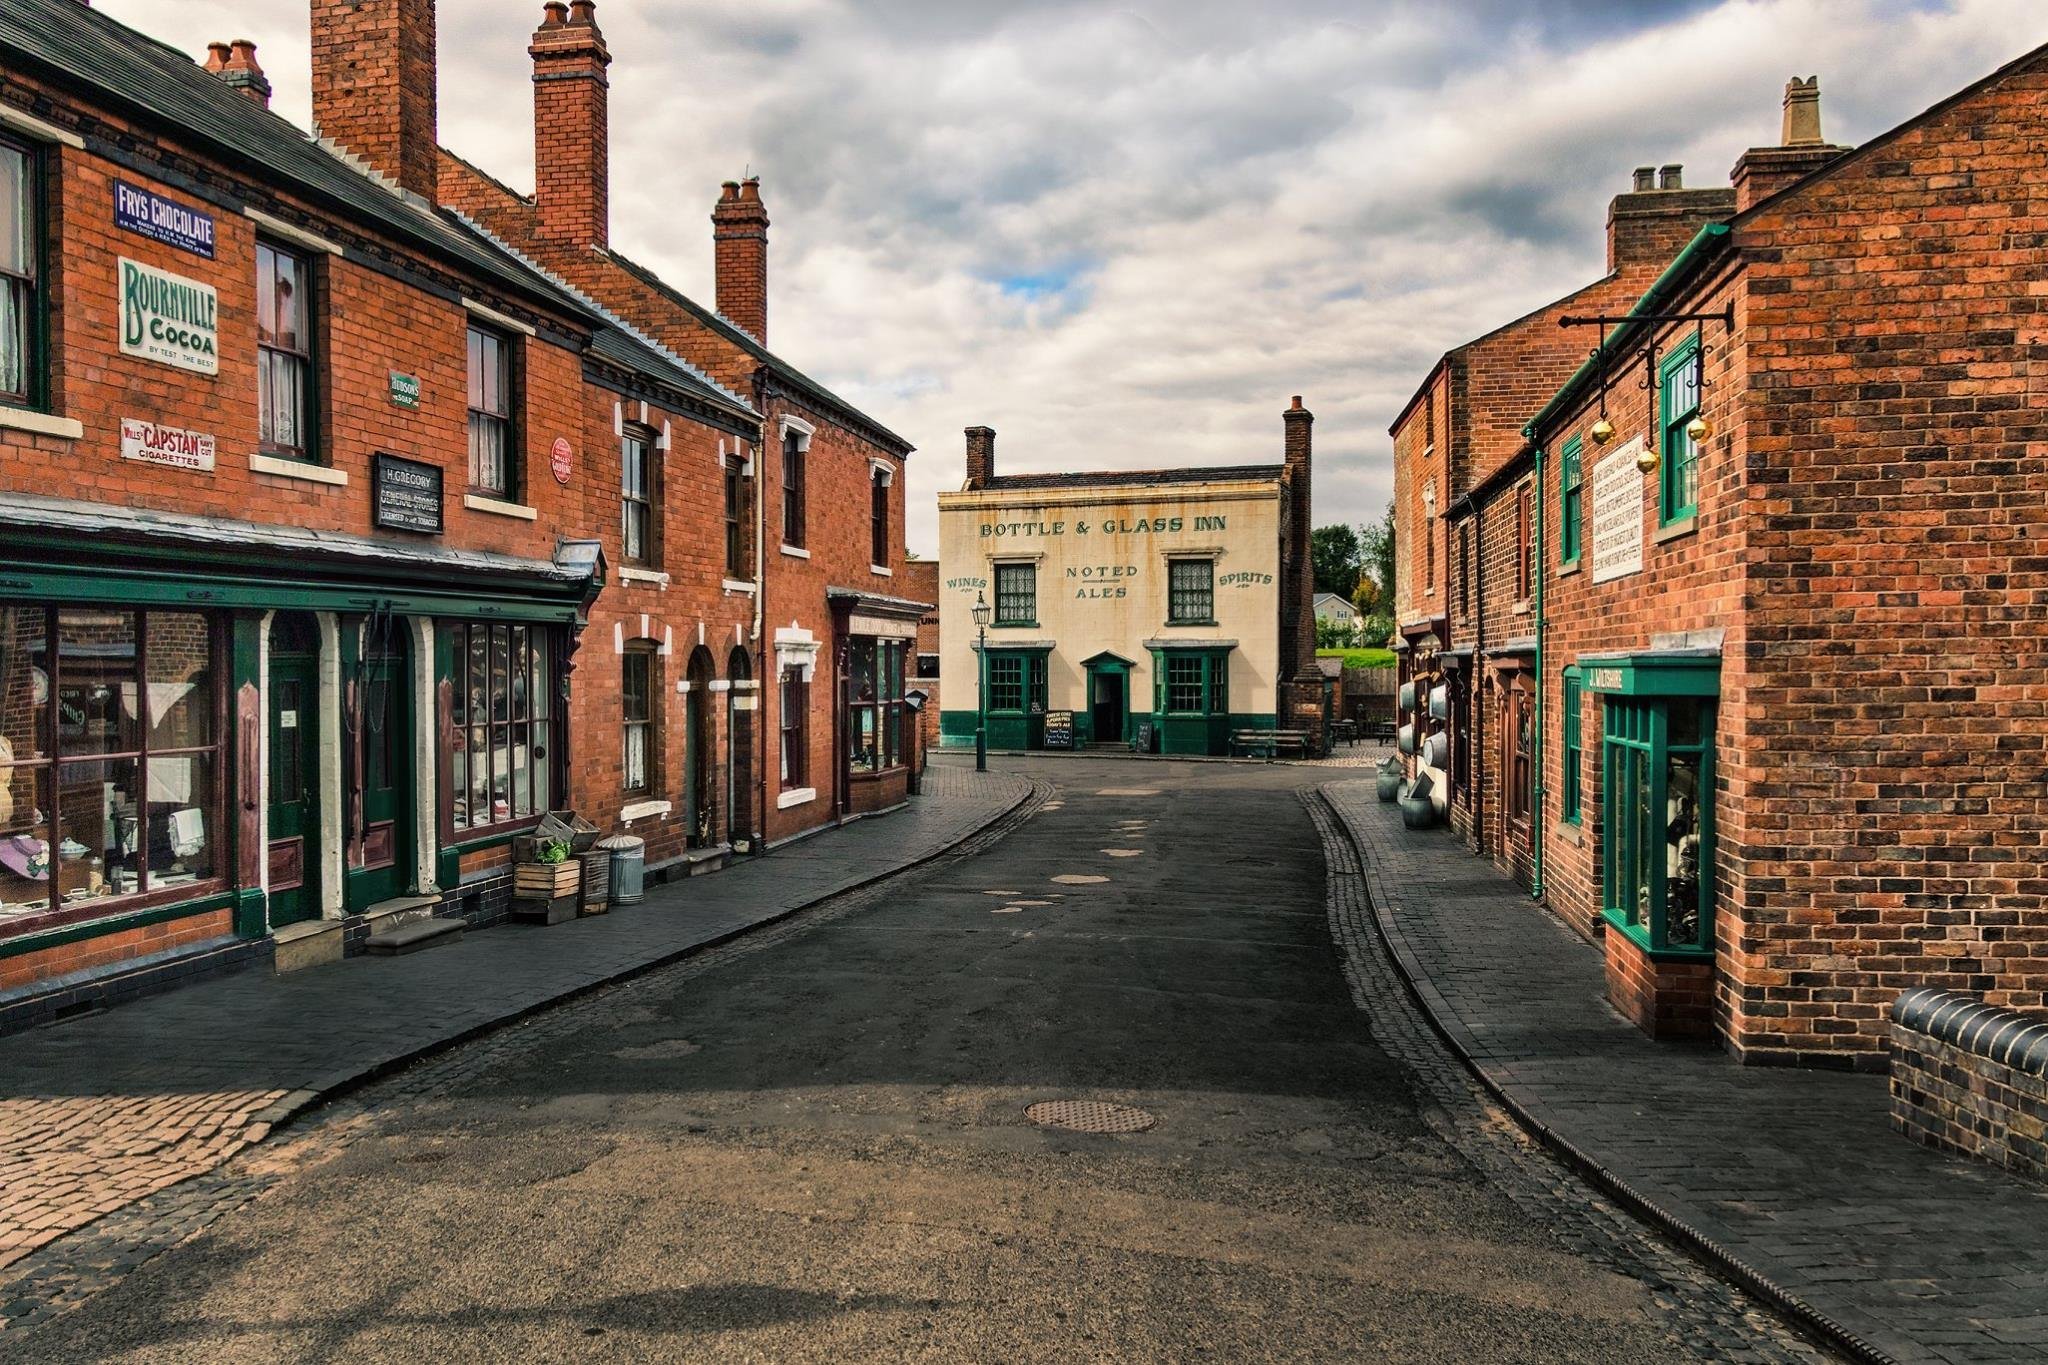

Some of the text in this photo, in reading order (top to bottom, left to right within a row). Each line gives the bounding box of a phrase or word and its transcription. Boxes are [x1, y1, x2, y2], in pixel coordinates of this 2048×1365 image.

[118, 185, 213, 244] FRY'S CHOCOLATE
[124, 262, 215, 346] BOURNVILLE
[149, 317, 215, 355] COCOA
[149, 345, 214, 368] BY TEST THE BEST
[138, 449, 200, 467] CIGARETTES
[380, 489, 439, 512] GENERAL STORES
[980, 515, 1226, 537] BOTTLE & GLASS INN
[1066, 566, 1138, 577] NOTED
[1219, 572, 1273, 586] SPIRITS
[946, 577, 987, 589] WINES
[1075, 587, 1127, 599] ALES
